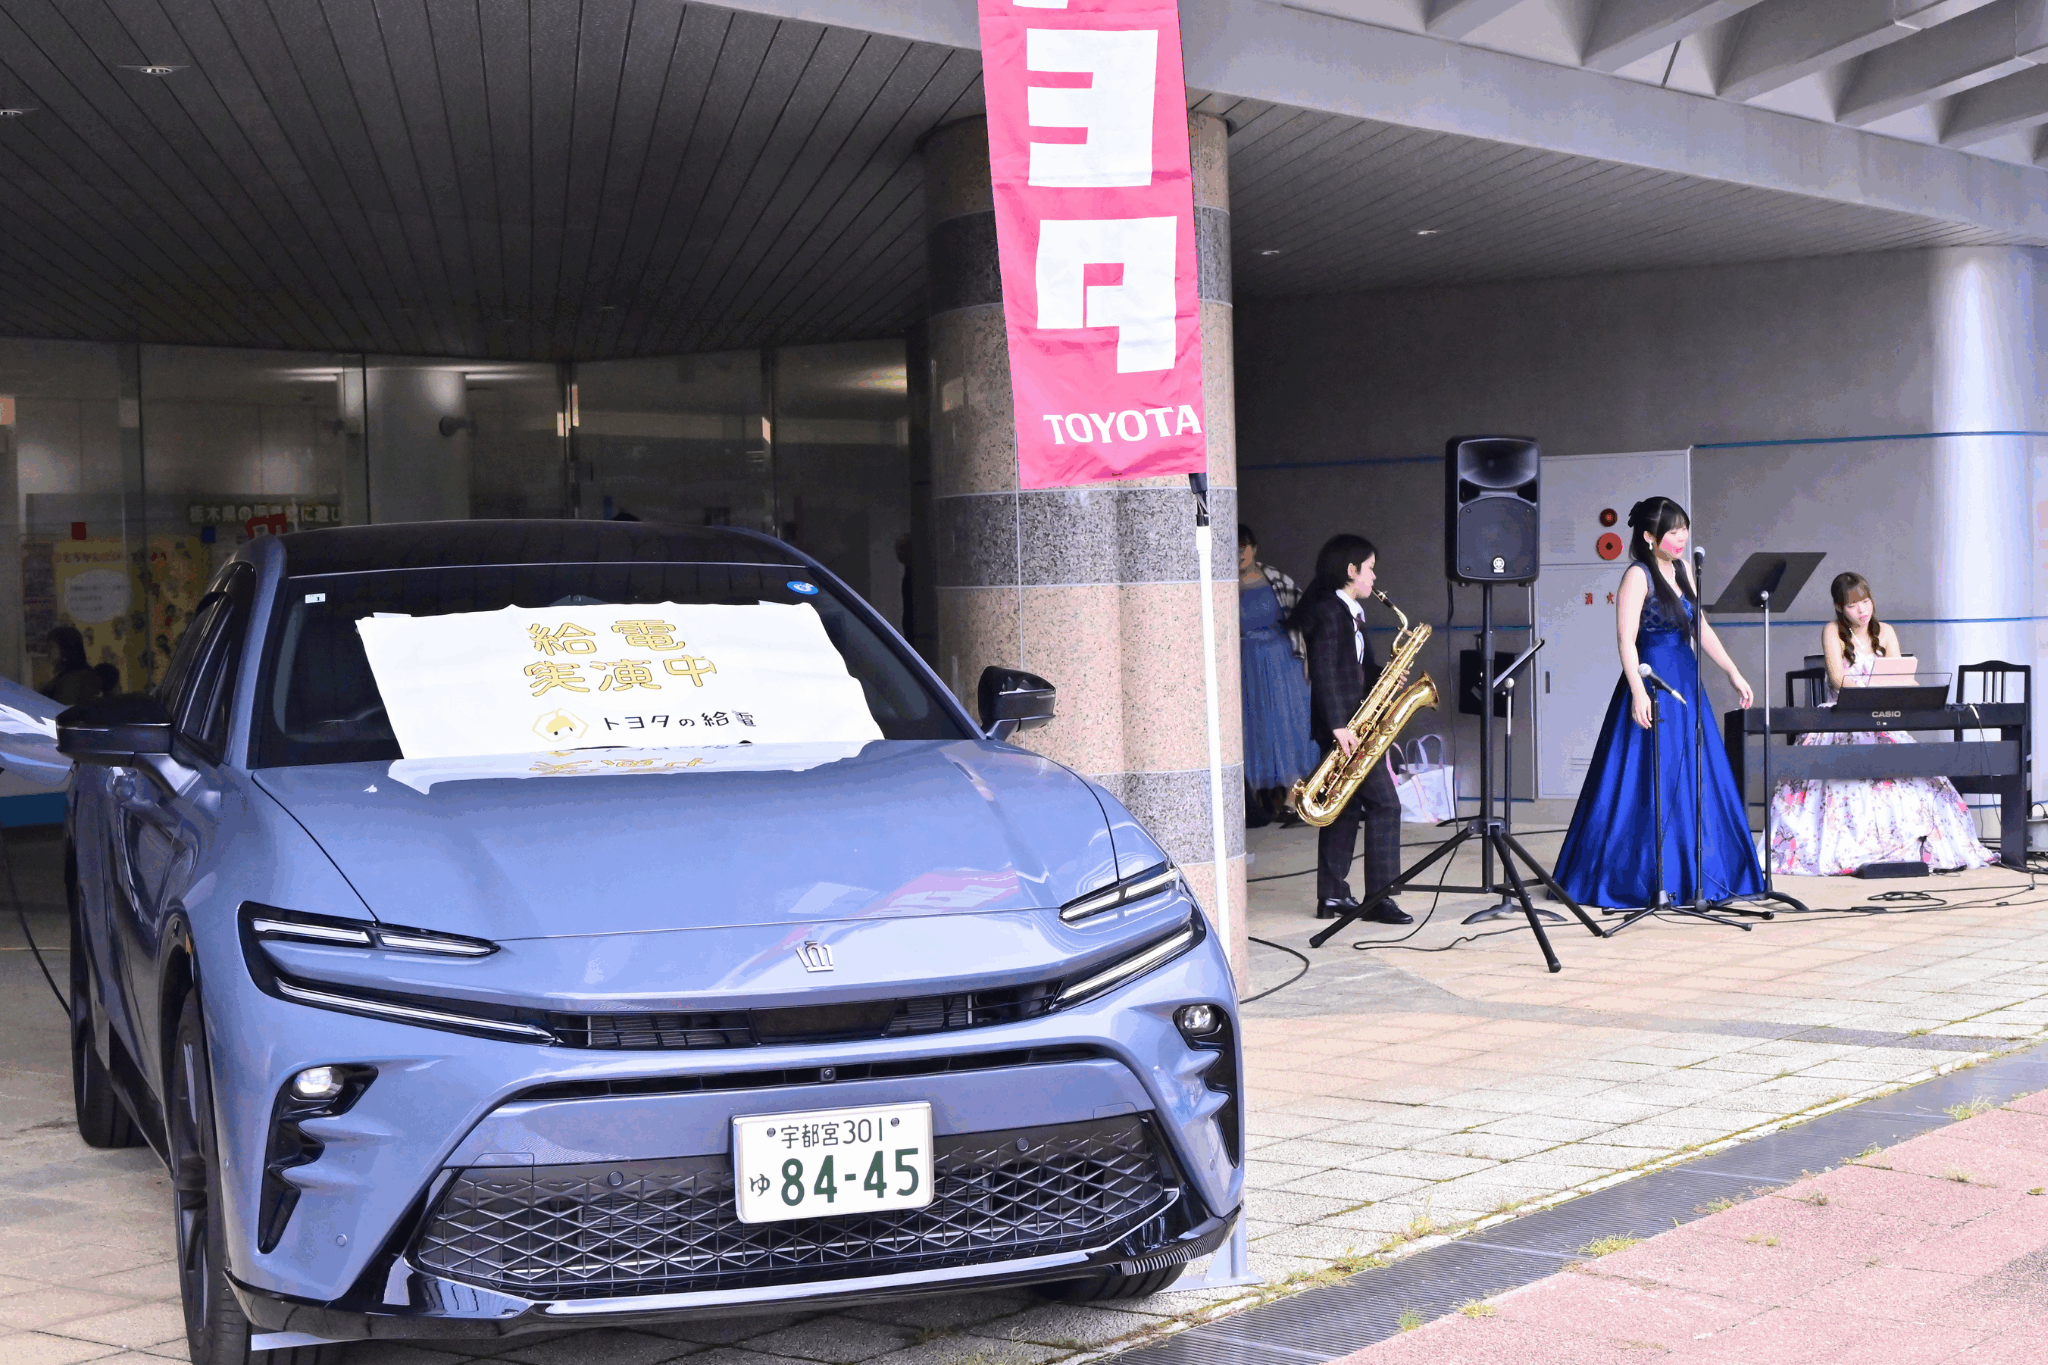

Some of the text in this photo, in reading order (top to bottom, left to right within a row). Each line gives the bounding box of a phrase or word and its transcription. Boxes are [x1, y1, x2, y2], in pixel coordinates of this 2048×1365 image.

[1013, 0, 1177, 373] ヨタ
[1043, 404, 1203, 444] TOYOTA
[526, 619, 686, 655] 給電
[523, 654, 717, 697] 実演中
[604, 710, 756, 731] トヨタの給電
[1871, 710, 1902, 718] CASIO
[749, 1147, 920, 1206] ゆ 84-45
